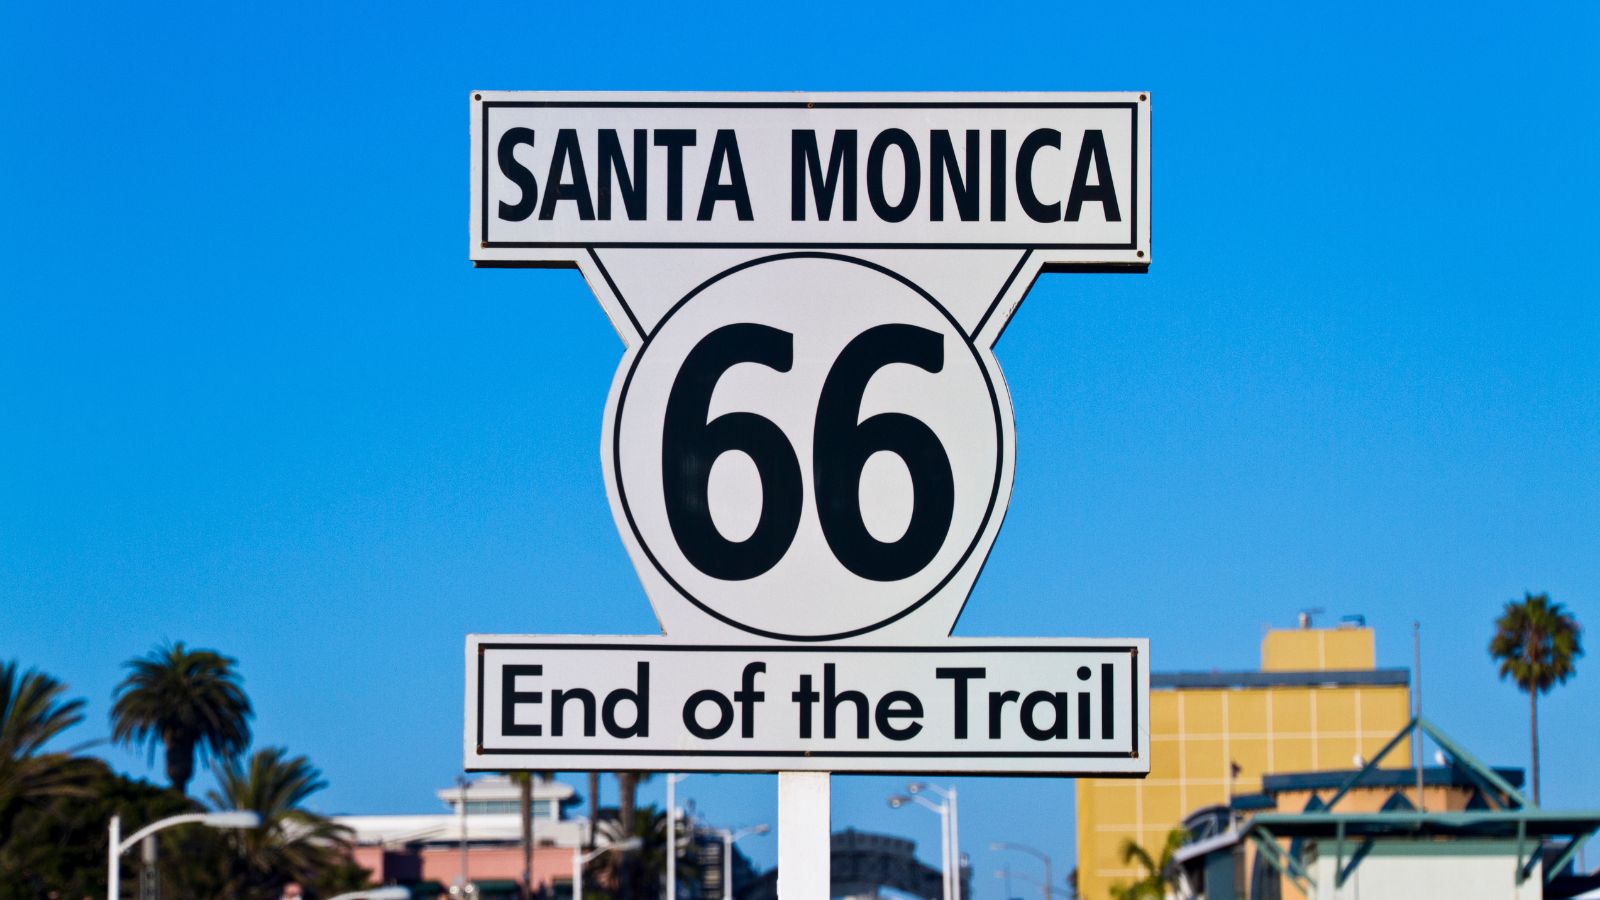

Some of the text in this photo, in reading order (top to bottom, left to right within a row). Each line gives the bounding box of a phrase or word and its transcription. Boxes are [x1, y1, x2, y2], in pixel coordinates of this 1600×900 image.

[498, 127, 1121, 223] SANTA MONICA
[662, 323, 954, 581] 66
[502, 662, 1114, 741] End of the Trail
